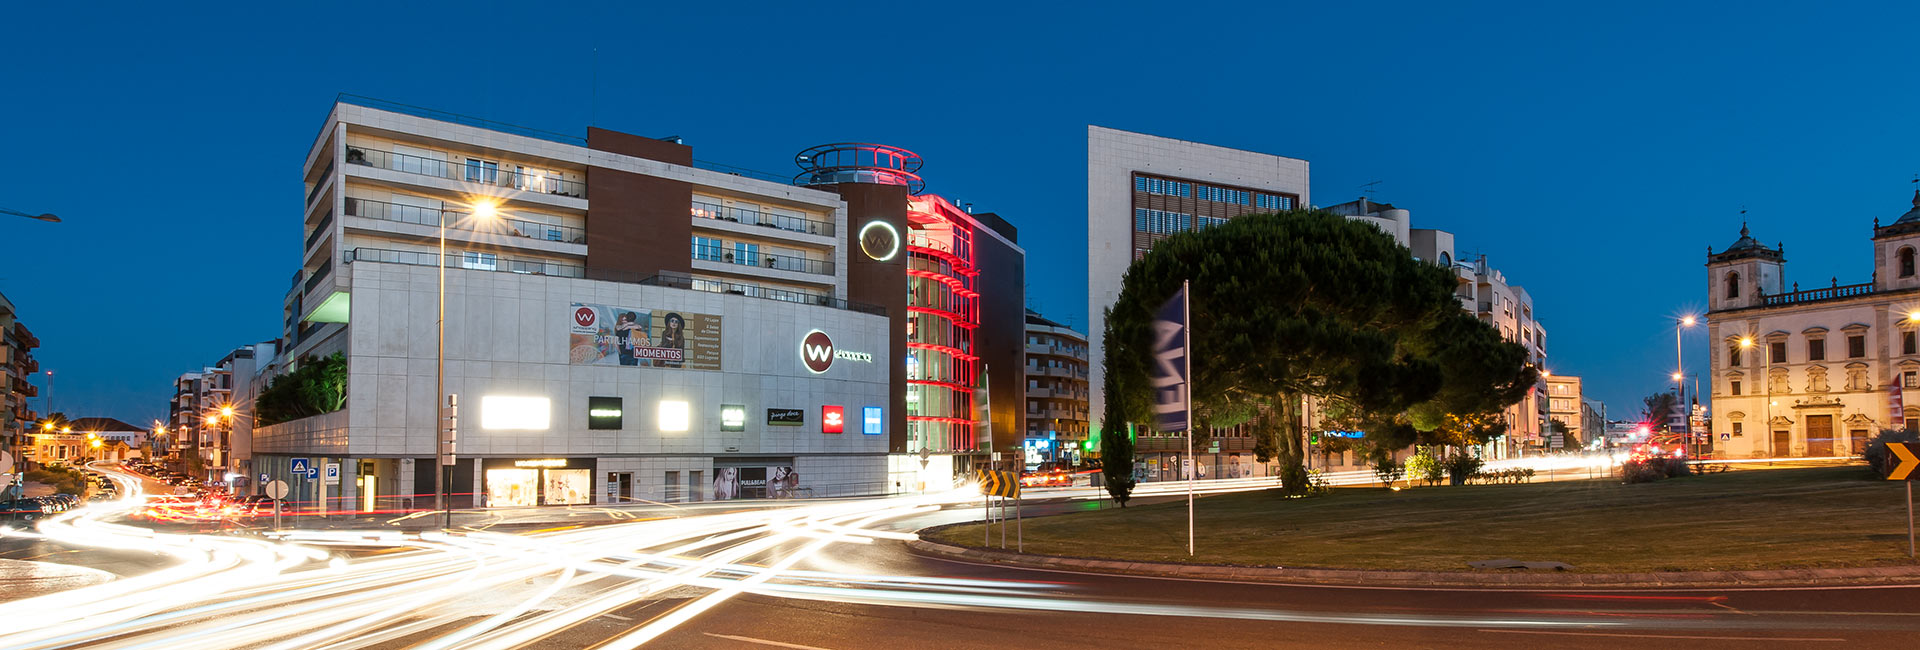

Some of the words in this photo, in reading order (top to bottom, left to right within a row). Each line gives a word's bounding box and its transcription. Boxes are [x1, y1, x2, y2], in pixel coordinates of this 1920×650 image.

[577, 312, 593, 322] W
[593, 335, 651, 347] PARTILHAMOS
[635, 348, 681, 359] MOMENTOS
[806, 343, 831, 362] W
